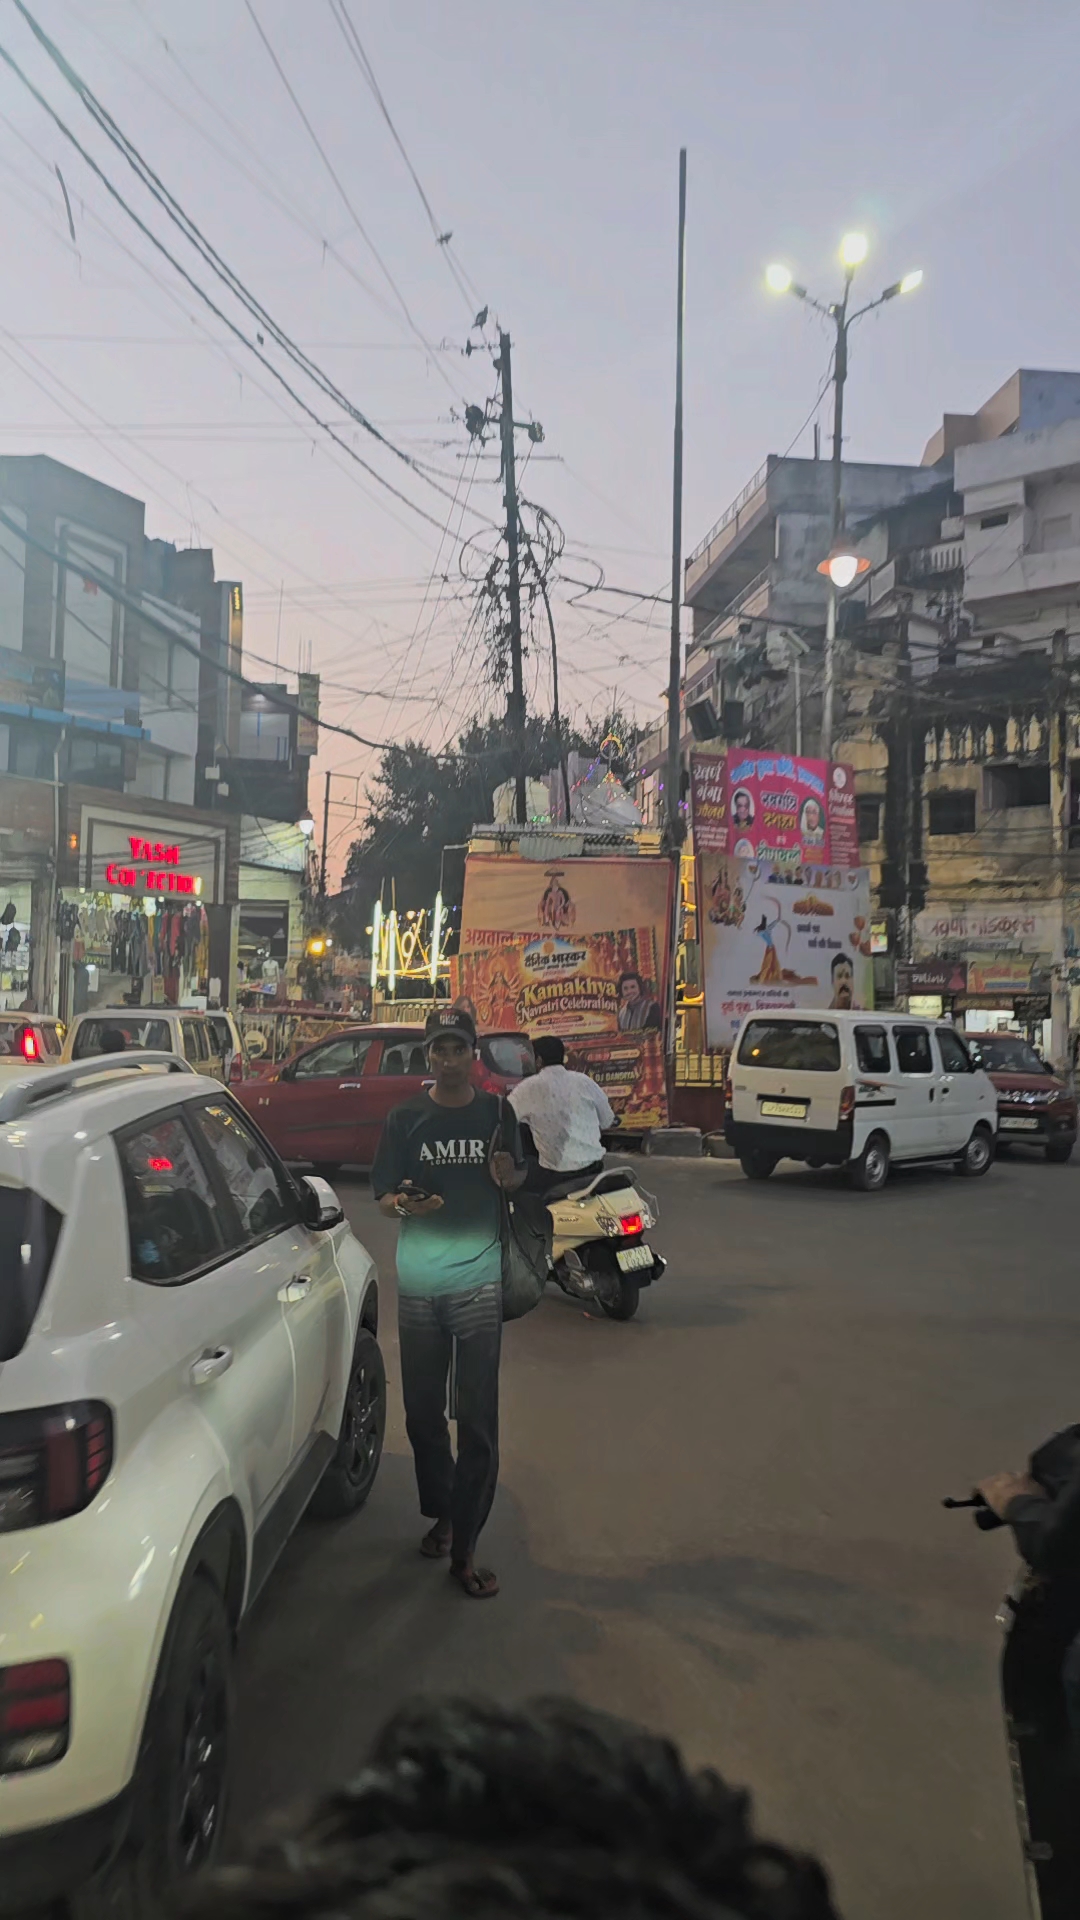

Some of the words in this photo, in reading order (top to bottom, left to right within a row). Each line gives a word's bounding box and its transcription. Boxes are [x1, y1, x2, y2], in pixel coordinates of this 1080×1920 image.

[524, 952, 550, 970] दैनिक
[550, 950, 587, 964] भास्कर
[522, 976, 618, 1007] Kamakhya
[515, 999, 559, 1025] Navratri
[560, 996, 617, 1012] Celebration
[419, 1139, 486, 1161] AMIR
